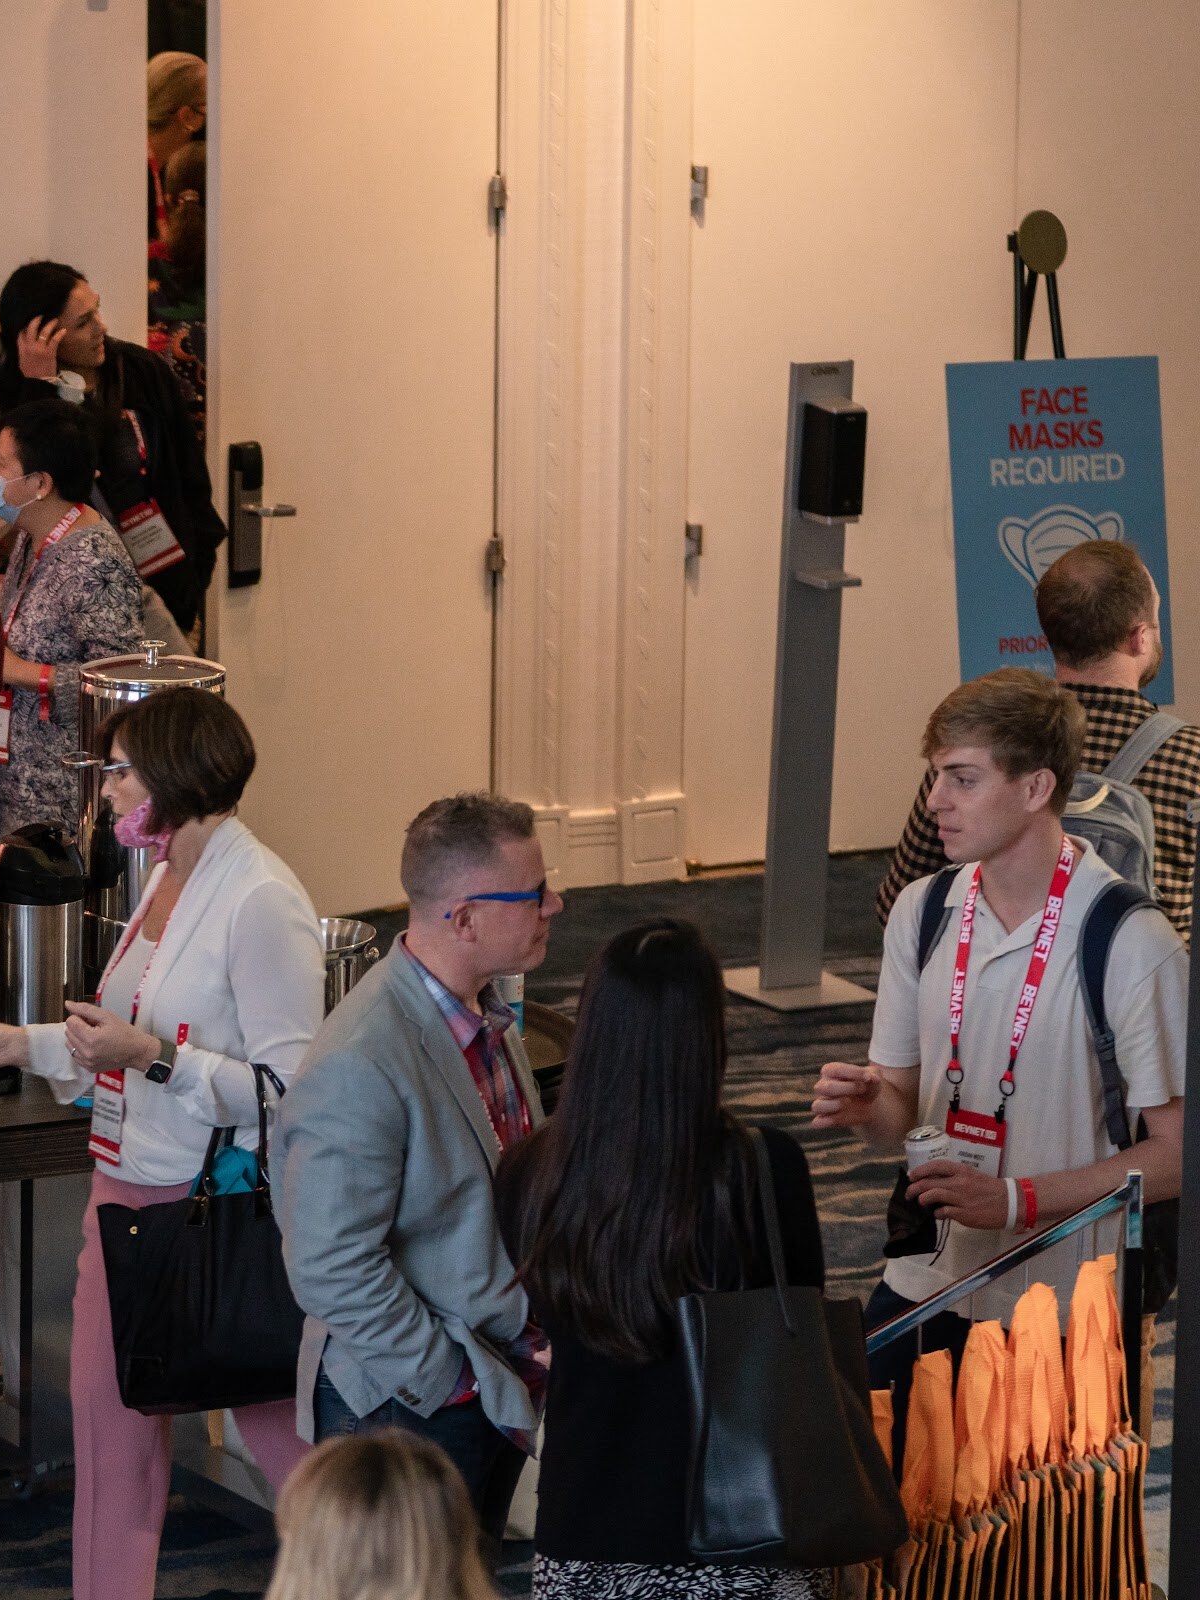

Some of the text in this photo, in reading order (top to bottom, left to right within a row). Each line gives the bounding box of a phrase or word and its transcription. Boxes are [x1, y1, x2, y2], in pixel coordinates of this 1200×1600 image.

[1020, 386, 1089, 416] FACE
[1008, 419, 1104, 451] MASKS
[989, 452, 1126, 486] REQUIRED
[1057, 833, 1075, 876] NET
[959, 879, 979, 944] BEVNET
[1033, 895, 1063, 963] BEVNET
[950, 967, 967, 1035] BEVNET
[1009, 983, 1037, 1050] BEVNET
